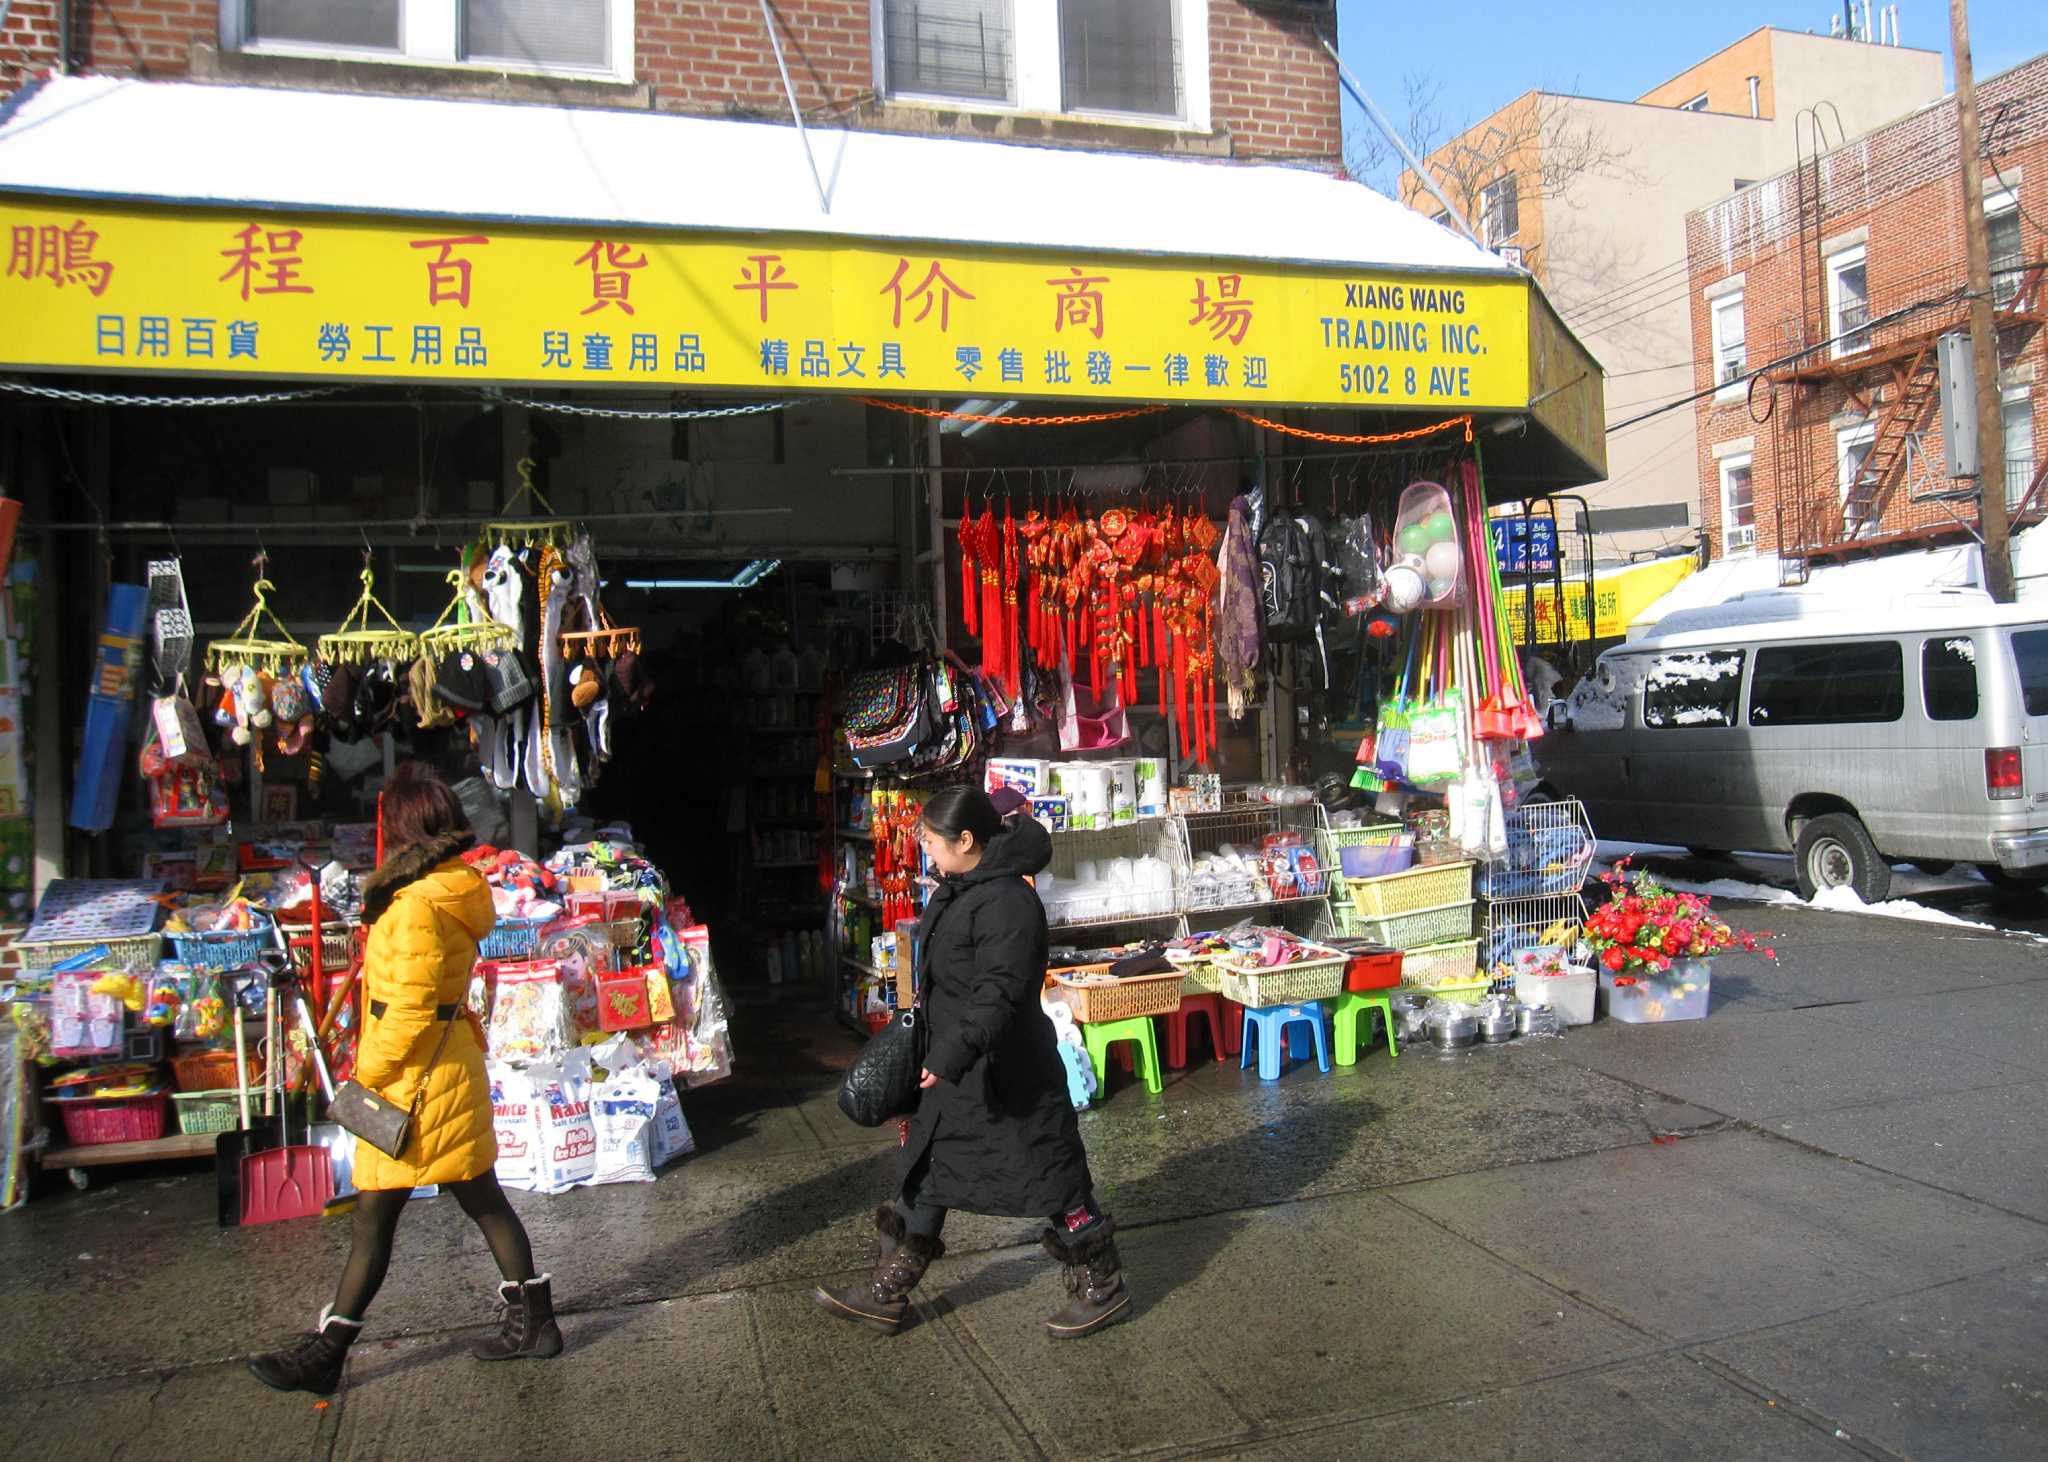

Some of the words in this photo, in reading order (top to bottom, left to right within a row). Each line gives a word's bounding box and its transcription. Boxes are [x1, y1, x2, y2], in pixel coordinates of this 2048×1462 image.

[1344, 283, 1405, 310] XIANG
[1410, 287, 1466, 314] WANG
[96, 314, 259, 359] 日用百貨
[318, 322, 488, 368] 勞工用品
[541, 330, 706, 373] 兒童用品
[760, 338, 906, 378] 精品文具
[1320, 317, 1428, 353] TRADING
[1441, 323, 1489, 355] INC.
[1340, 363, 1390, 394] 5102
[1404, 366, 1417, 396] 8
[1429, 366, 1471, 397] AVE
